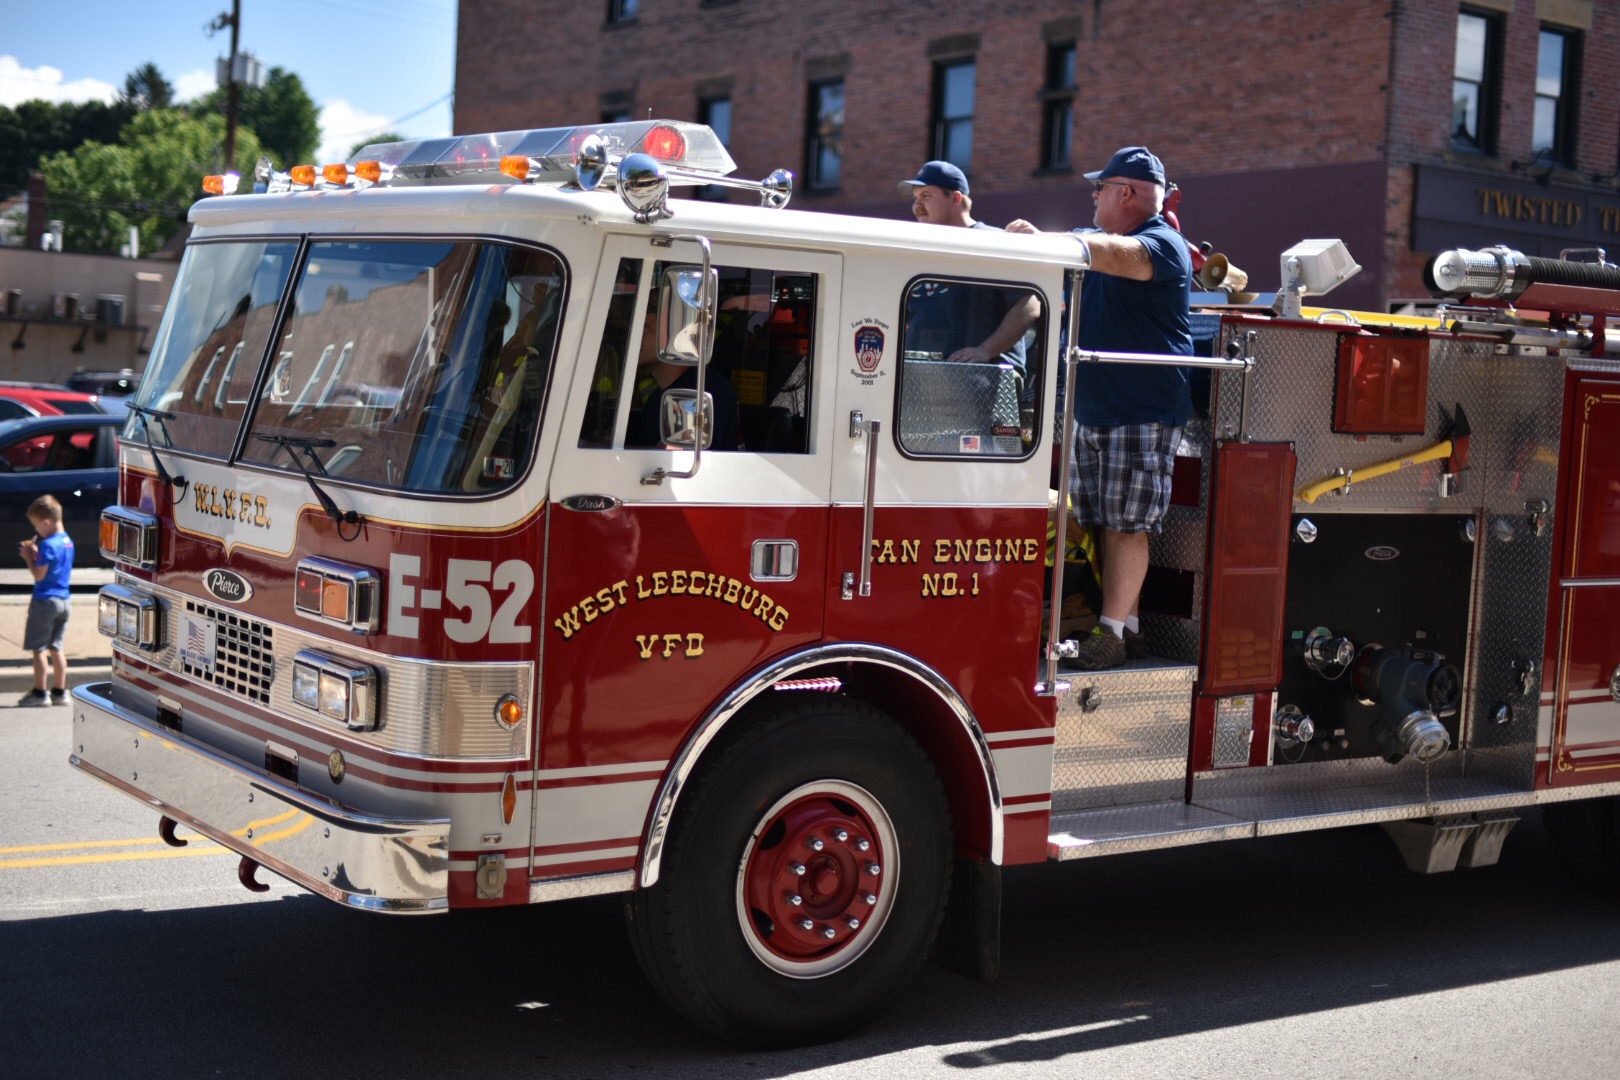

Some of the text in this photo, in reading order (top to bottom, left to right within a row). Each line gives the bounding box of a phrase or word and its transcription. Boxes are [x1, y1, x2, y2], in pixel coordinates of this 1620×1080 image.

[1480, 189, 1582, 226] TWISTED
[850, 368, 878, 379] September
[577, 497, 605, 509] Dash
[934, 538, 1039, 563] ENGINE
[211, 571, 240, 596] Pierce
[387, 552, 535, 644] E-52
[554, 570, 790, 639] WEST LEECHBURG
[636, 632, 705, 659] VFD
